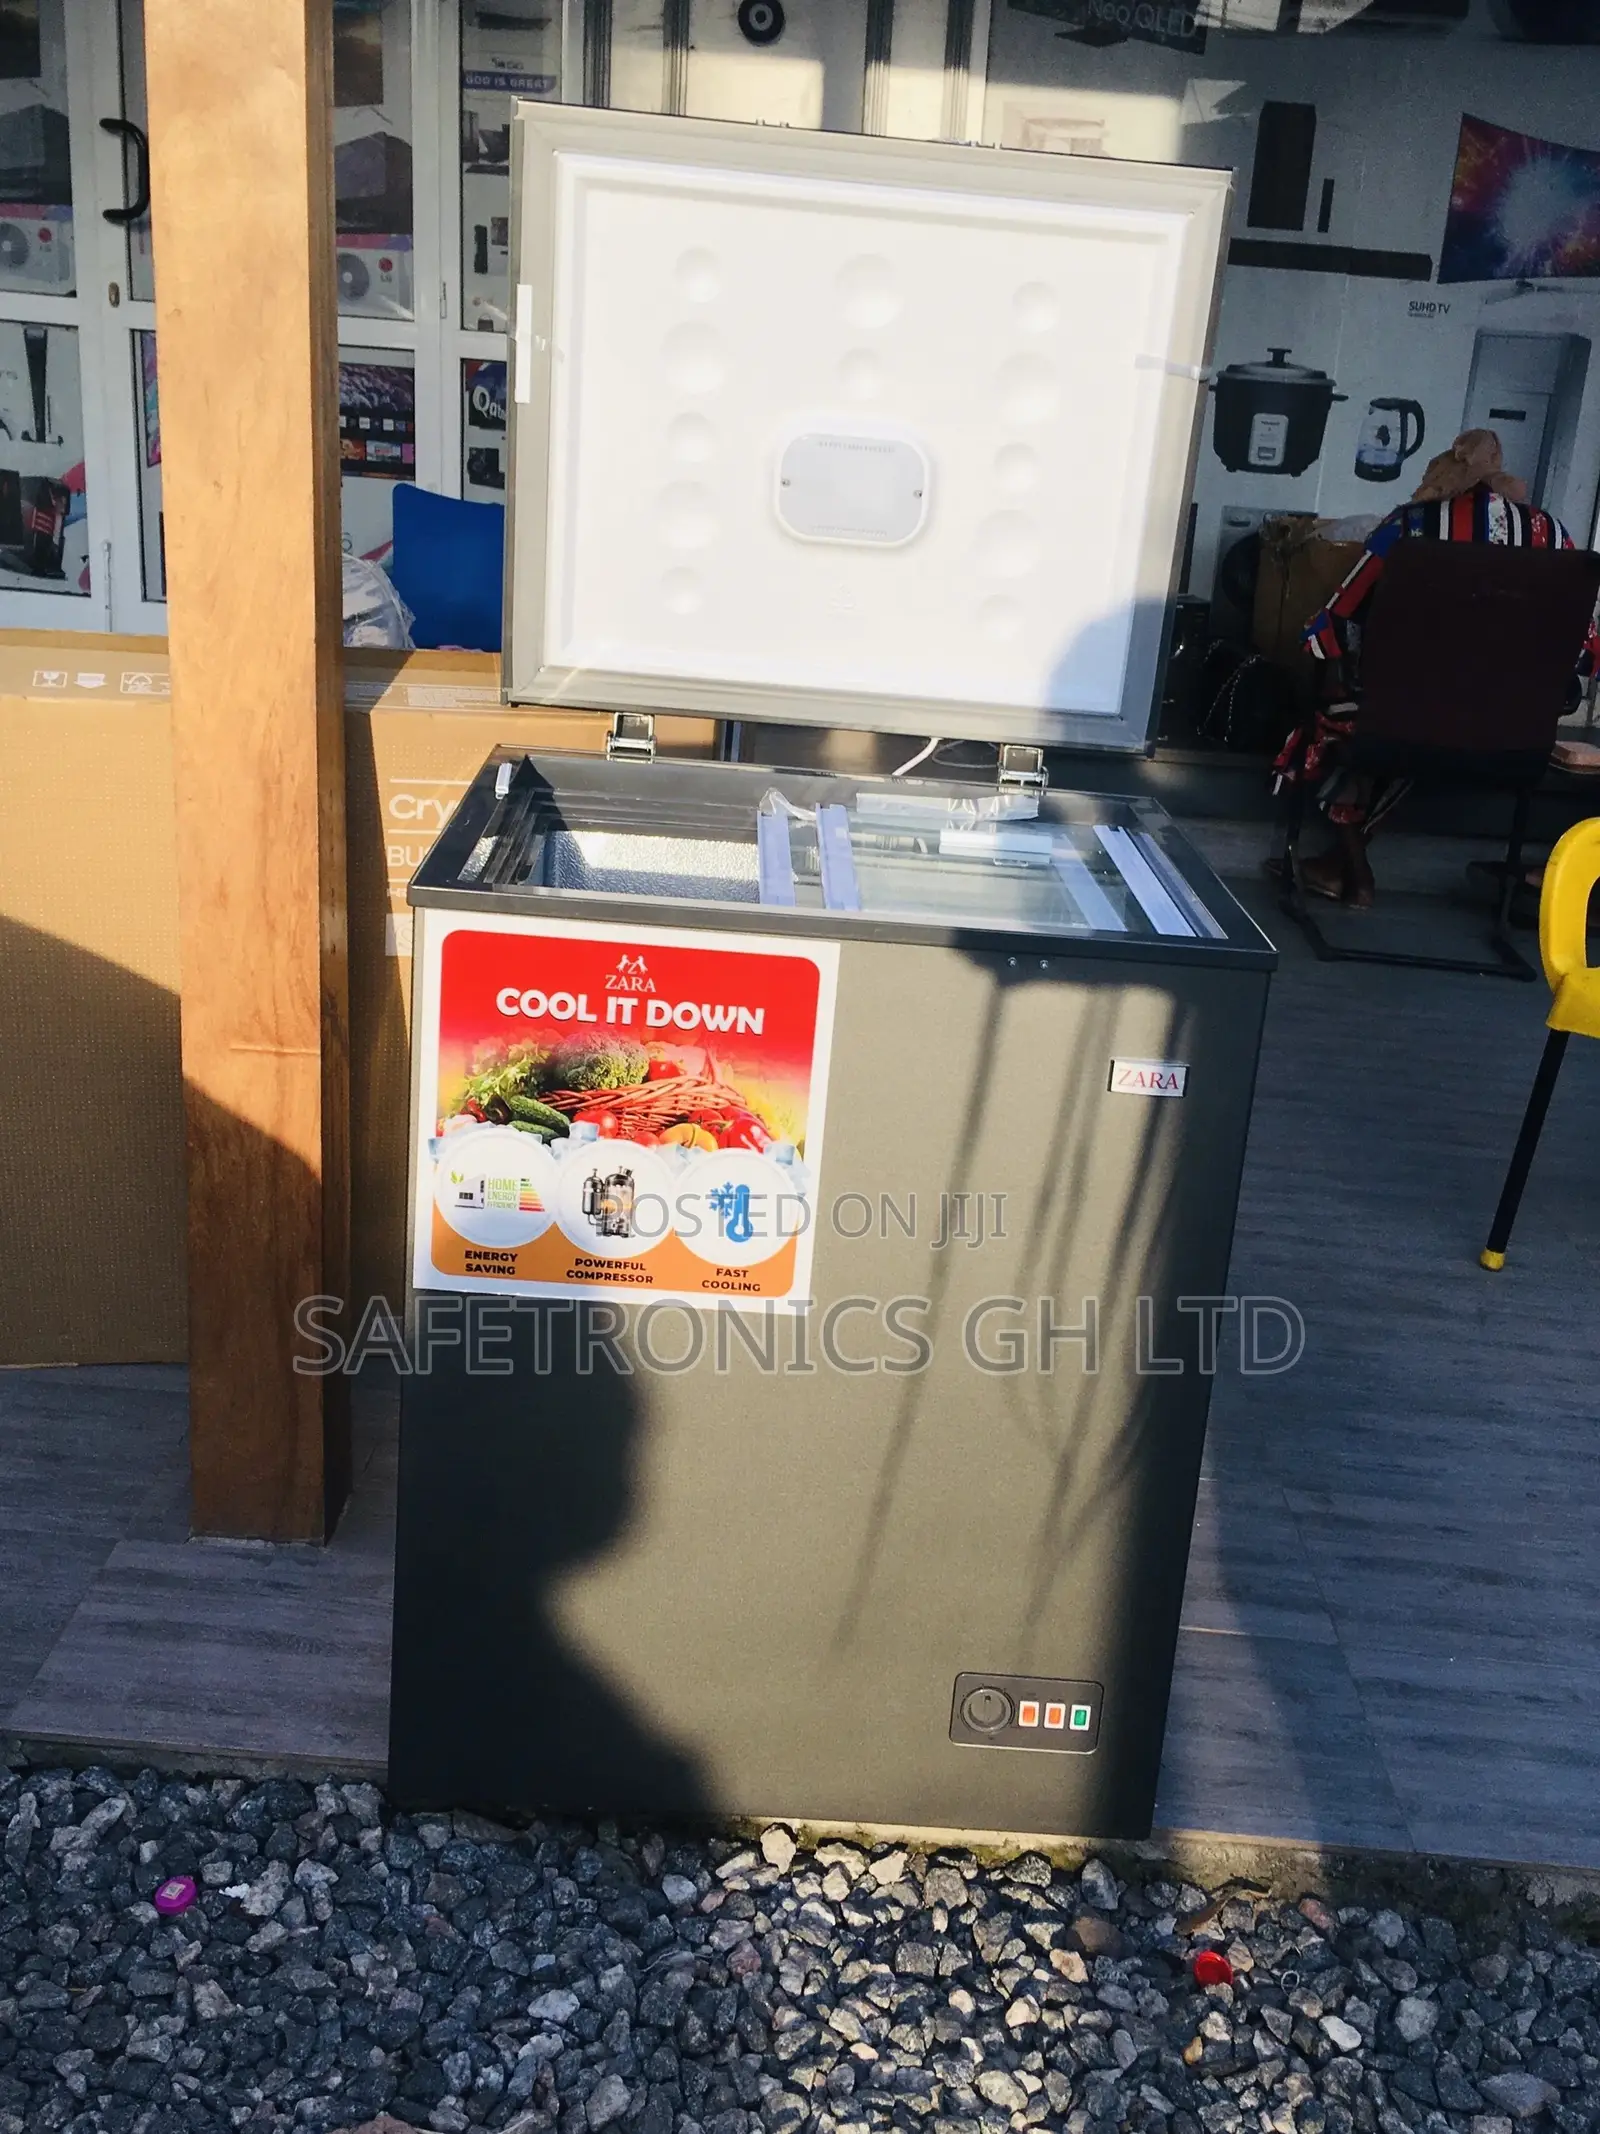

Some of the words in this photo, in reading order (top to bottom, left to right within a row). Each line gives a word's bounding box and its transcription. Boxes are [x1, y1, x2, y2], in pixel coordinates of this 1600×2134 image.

[1437, 303, 1451, 314] TV
[388, 794, 458, 829] Cry
[388, 845, 432, 867] BU
[604, 974, 657, 993] ZARA
[495, 987, 598, 1023] COOL
[606, 996, 639, 1025] IT
[646, 999, 765, 1035] DOWN
[1117, 1068, 1180, 1090] ZARA
[464, 1250, 519, 1263] ENERGY
[465, 1263, 516, 1276] SAVING
[574, 1258, 647, 1272] POWERFUL
[566, 1269, 654, 1285] COMPRESSOR
[716, 1267, 749, 1280] FAST
[701, 1279, 761, 1293] COOLING
